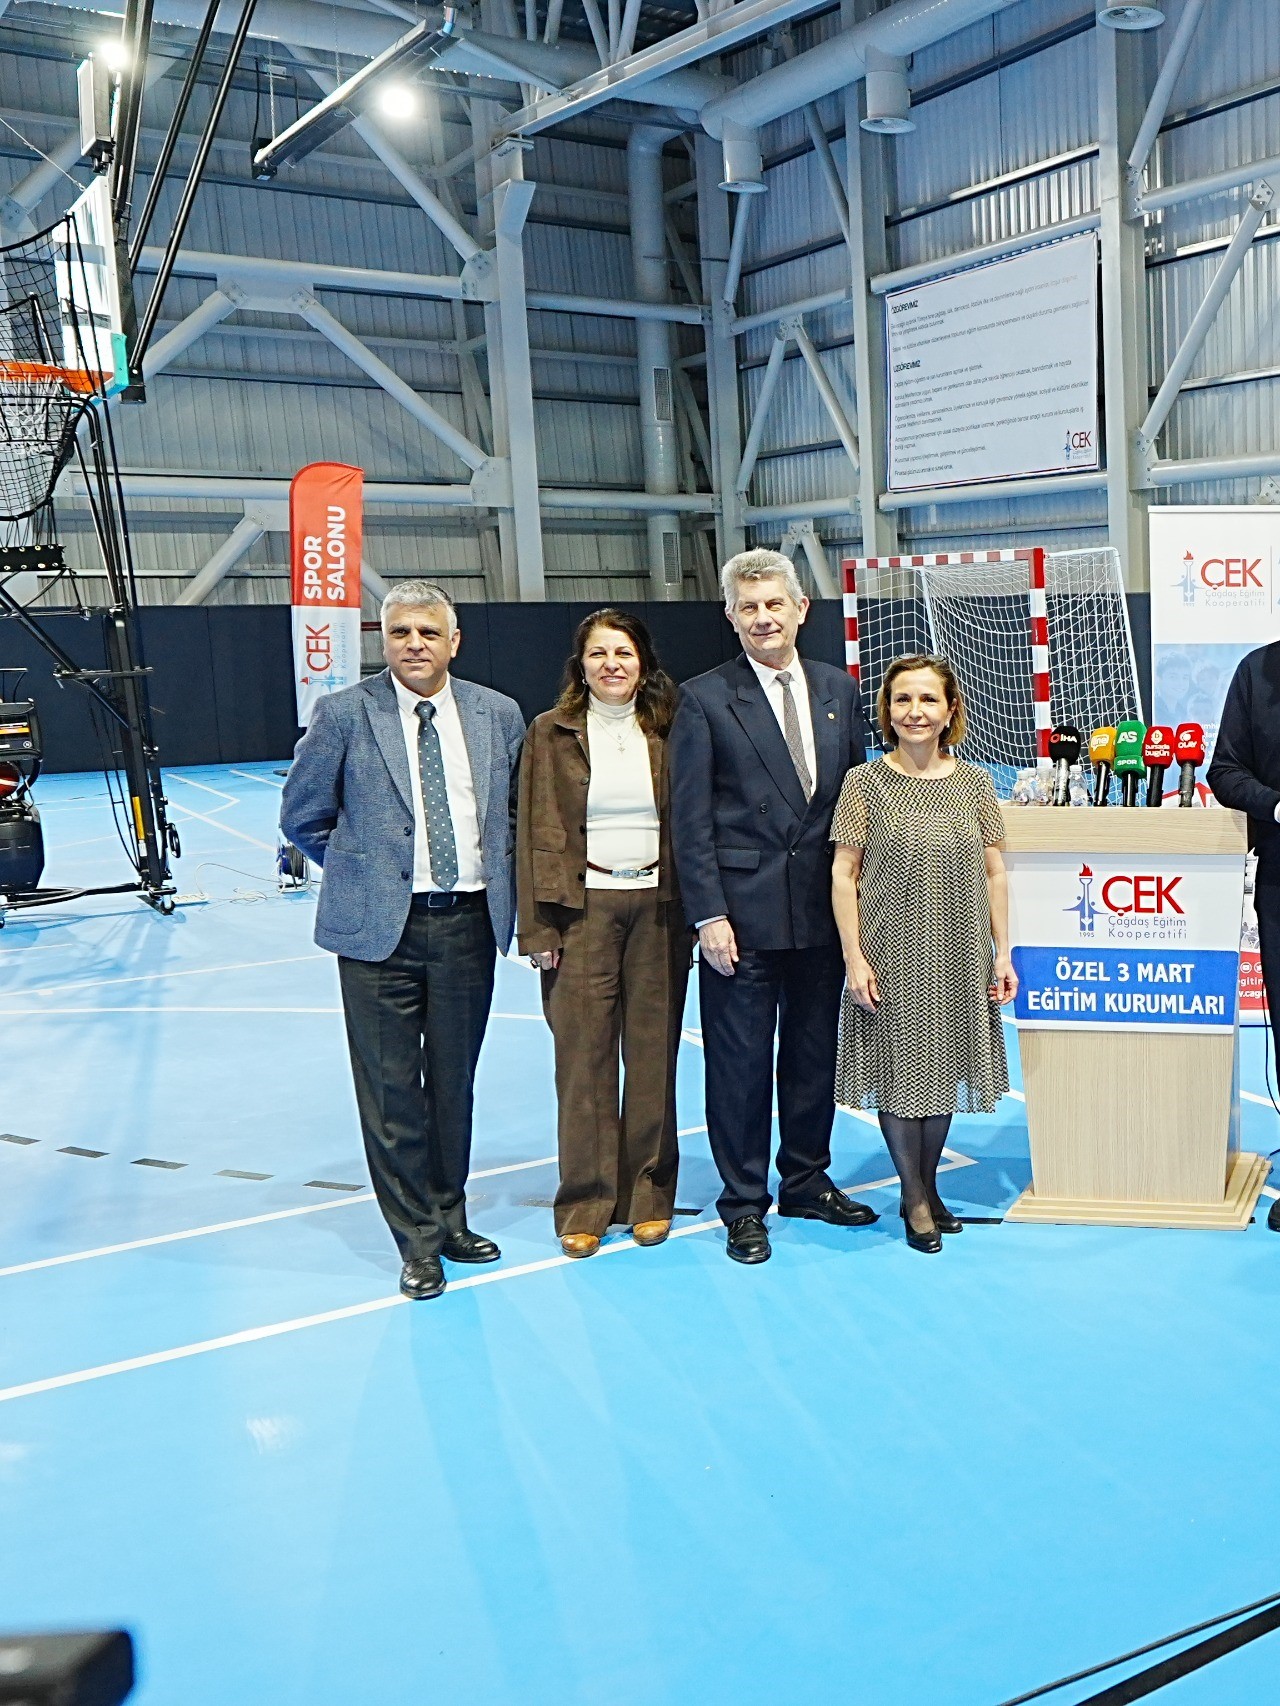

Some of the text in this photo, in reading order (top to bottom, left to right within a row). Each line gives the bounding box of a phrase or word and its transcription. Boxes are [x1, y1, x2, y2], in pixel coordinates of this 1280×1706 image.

[303, 535, 323, 600] SPOR
[327, 505, 346, 601] SALONU
[1200, 558, 1264, 590] ÇEK
[305, 623, 333, 672] ÇEK
[1117, 731, 1138, 744] AS
[1101, 875, 1185, 916] ÇEK
[1108, 915, 1187, 928] Çağdaş Eğitim
[1108, 928, 1188, 940] Kooperatifi
[1055, 956, 1195, 984] ÖZEL 3 MART
[1027, 987, 1225, 1015] EĞİTİM KURUMLARI
